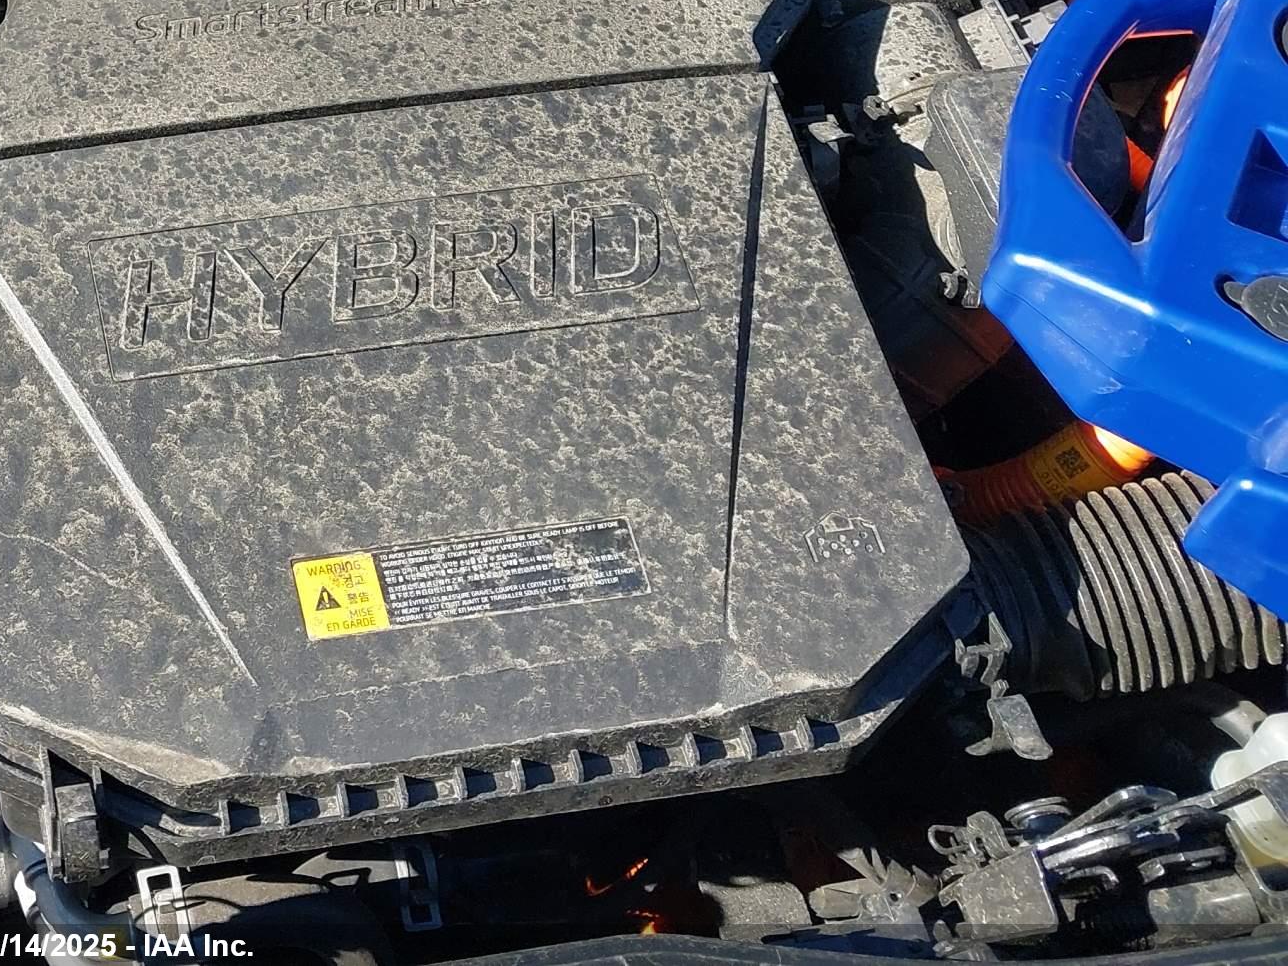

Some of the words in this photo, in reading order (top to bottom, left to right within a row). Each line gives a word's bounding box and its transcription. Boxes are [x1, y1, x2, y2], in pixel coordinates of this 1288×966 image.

[119, 201, 662, 350] HYBRID
[306, 560, 361, 577] WARNING
[341, 574, 365, 588] 경고
[349, 607, 374, 619] MISE
[326, 622, 340, 632] EN
[343, 616, 377, 630] GARDE
